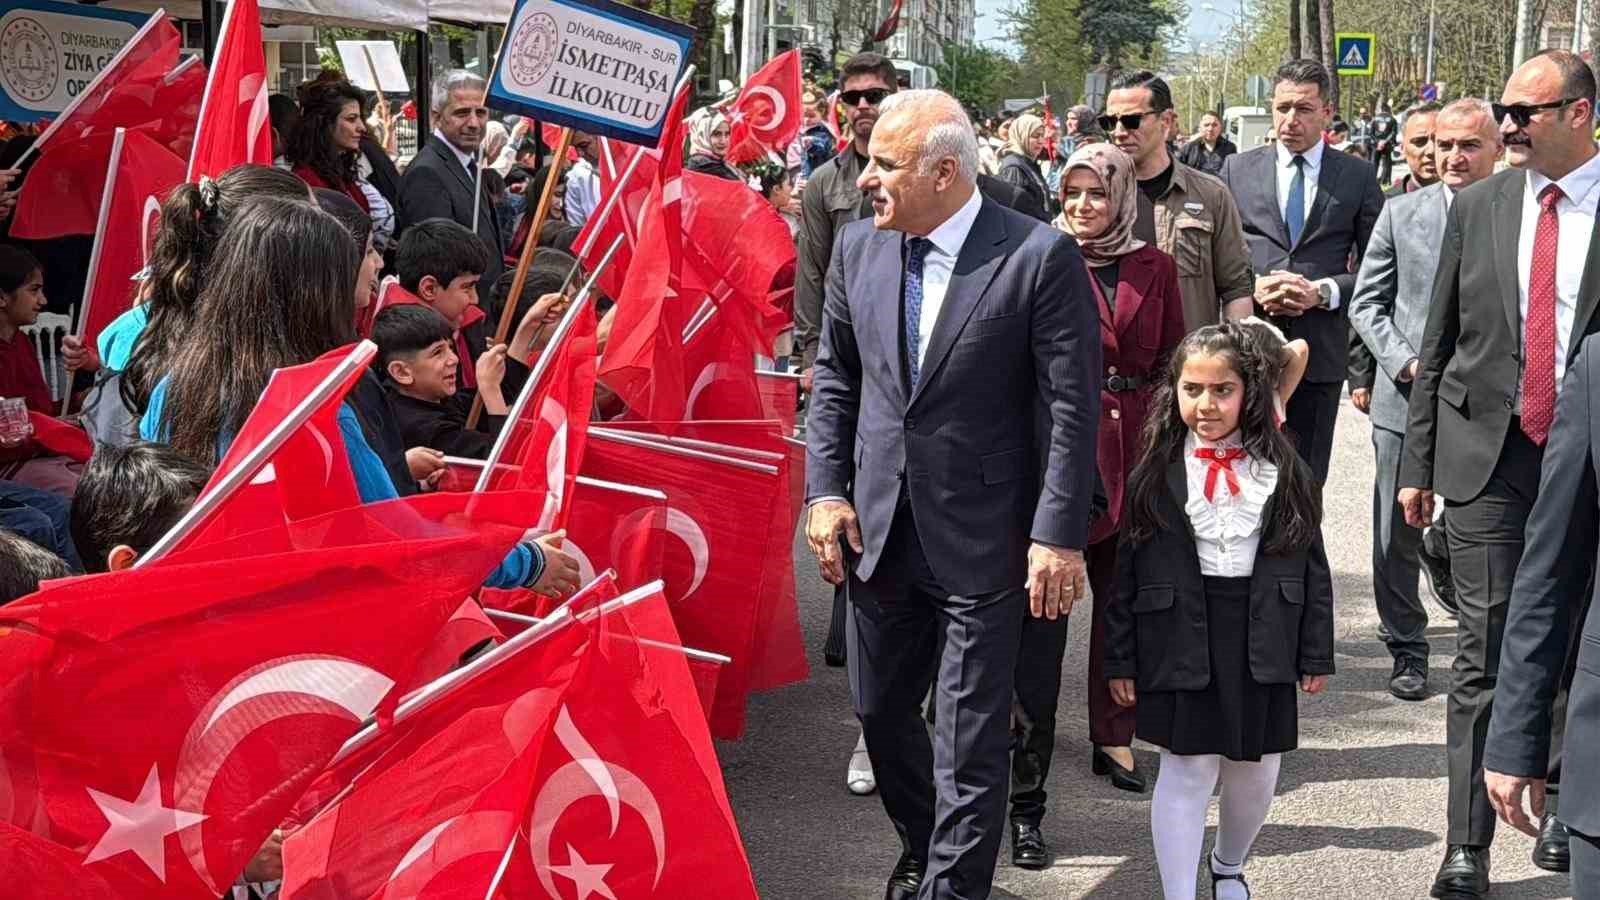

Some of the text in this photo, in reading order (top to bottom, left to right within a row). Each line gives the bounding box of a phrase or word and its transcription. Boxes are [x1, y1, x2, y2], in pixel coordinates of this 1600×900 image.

[64, 49, 95, 72] ZİYA
[557, 38, 667, 93] İSMETPAŞA
[567, 21, 643, 54] DİYARBAKIR
[651, 48, 677, 65] SUR
[548, 71, 660, 121] İLKOKULU
